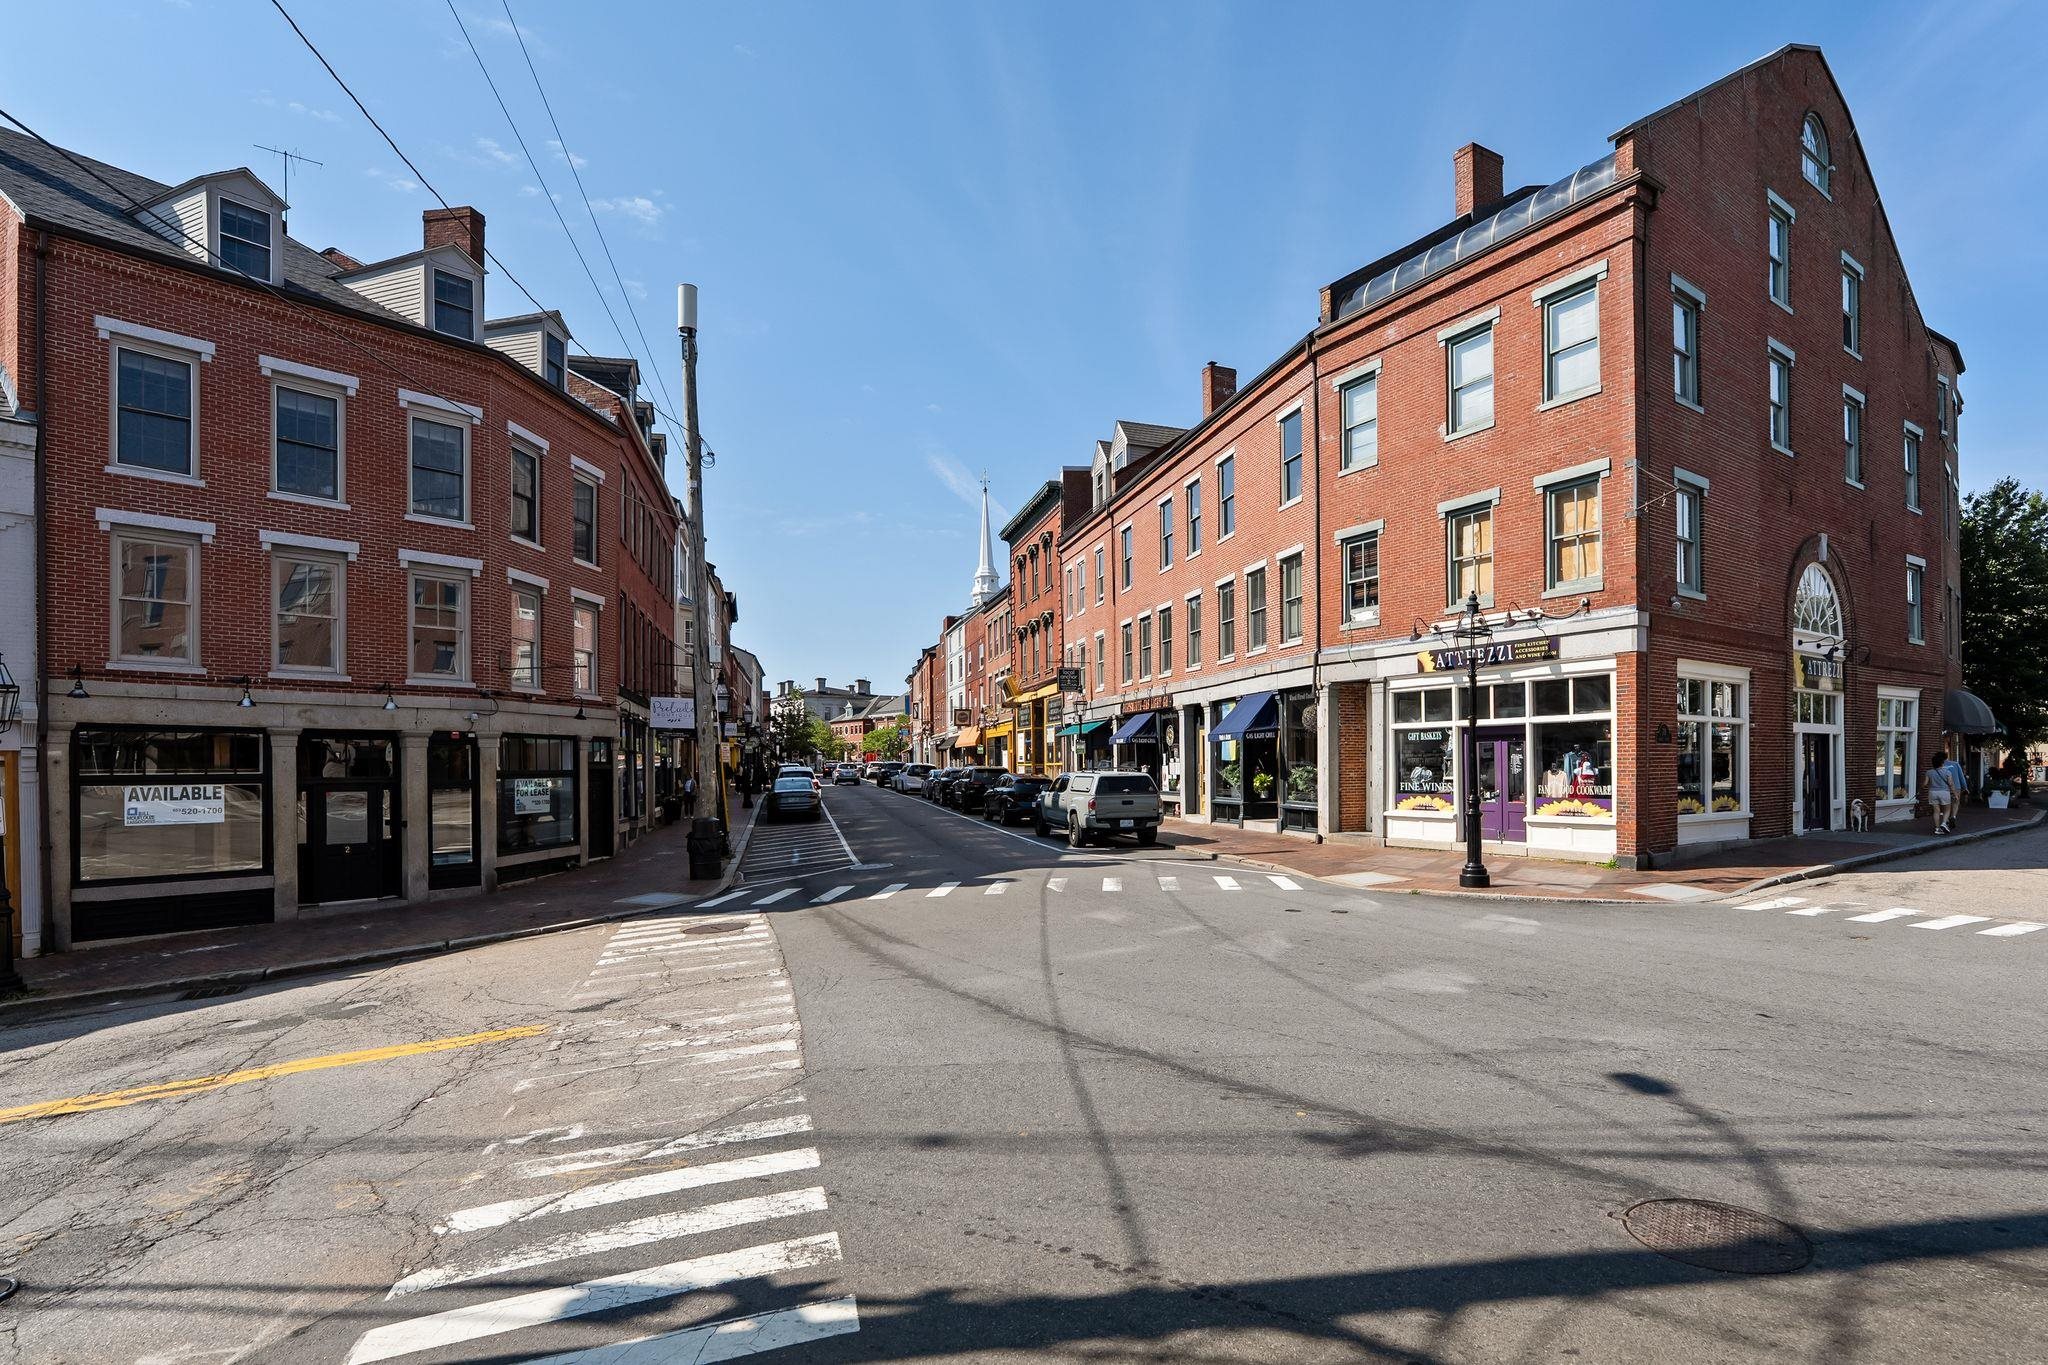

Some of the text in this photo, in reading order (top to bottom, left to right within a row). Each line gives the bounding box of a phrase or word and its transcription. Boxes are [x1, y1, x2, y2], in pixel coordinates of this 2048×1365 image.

[1515, 646, 1549, 654] ACCESSORIES
[1808, 660, 1843, 679] ATTREZZI
[652, 701, 695, 713] Prelude
[1407, 731, 1443, 741] GIFT BASKETS
[516, 780, 550, 788] AVAILABL
[1400, 781, 1454, 791] FINE WINES
[128, 786, 222, 802] AVAILABLE
[516, 788, 550, 797] FOR LEASE
[1576, 785, 1612, 796] COOKWARE
